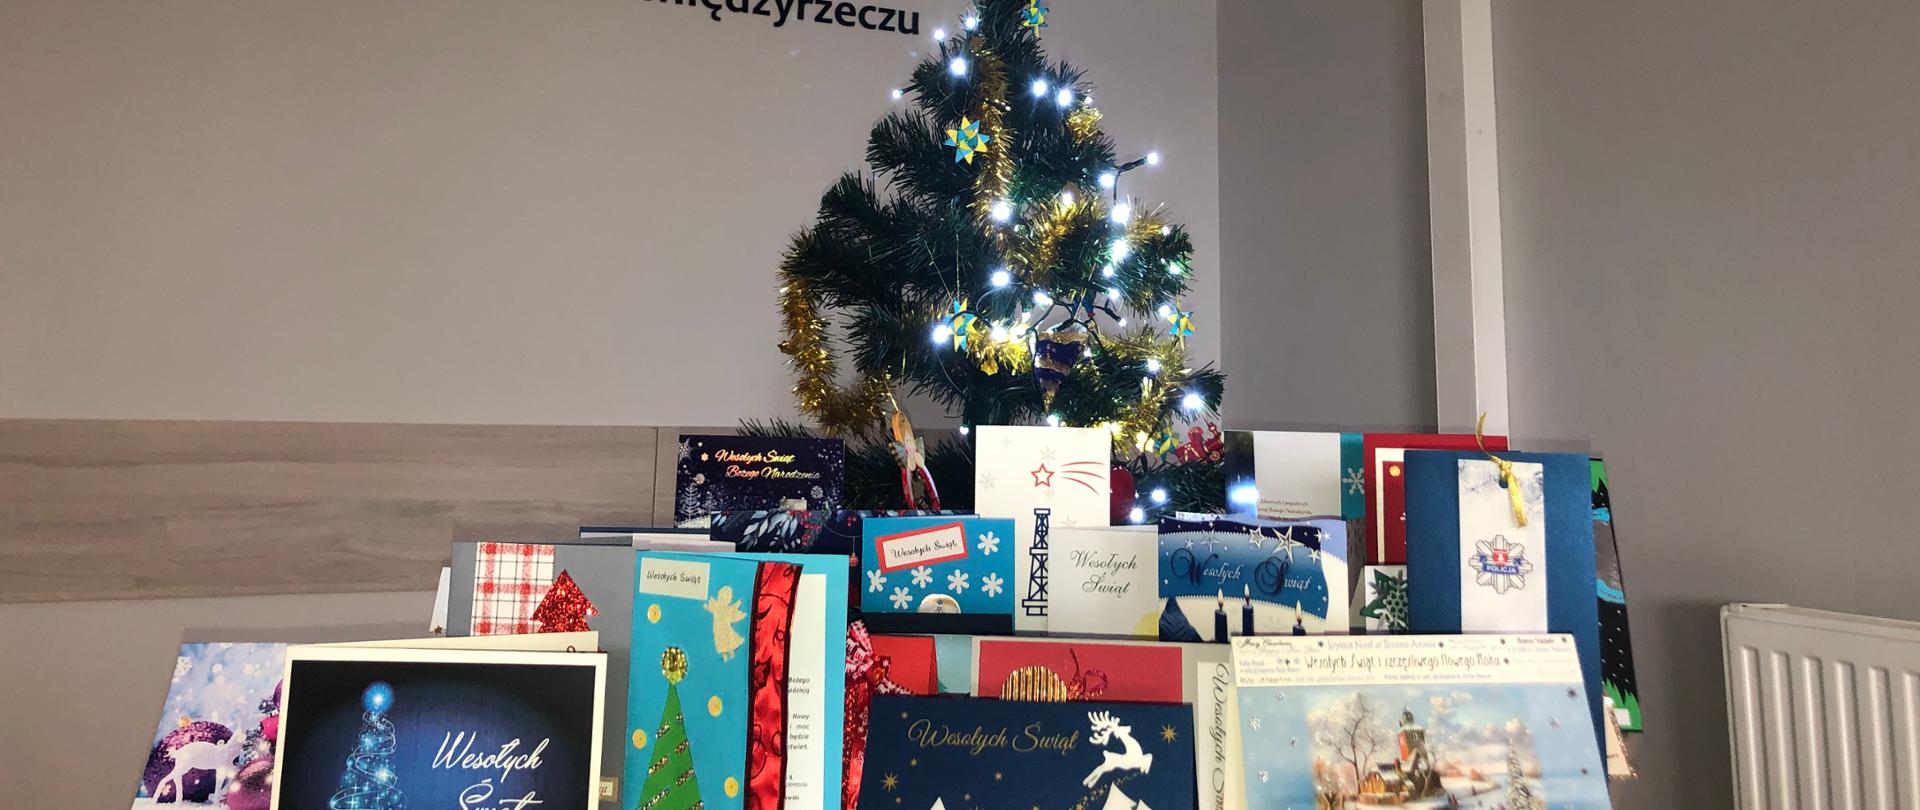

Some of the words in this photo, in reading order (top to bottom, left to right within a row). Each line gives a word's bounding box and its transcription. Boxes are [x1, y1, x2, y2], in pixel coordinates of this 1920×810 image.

[643, 0, 920, 35] ęzyrzeczu
[760, 466, 821, 480] Narodzenia
[891, 544, 931, 558] Wesołych
[1069, 550, 1138, 577] Wesołych
[646, 570, 677, 583] Wesołych
[1081, 571, 1131, 595] Świąt
[1170, 547, 1243, 587] Wesołych
[1254, 555, 1313, 596] Świąt
[1486, 565, 1517, 574] POLICJA
[1209, 663, 1230, 763] Wesołych
[907, 718, 1007, 756] Wesołych
[1012, 722, 1080, 756] Świąt
[432, 731, 550, 783] Wesołych
